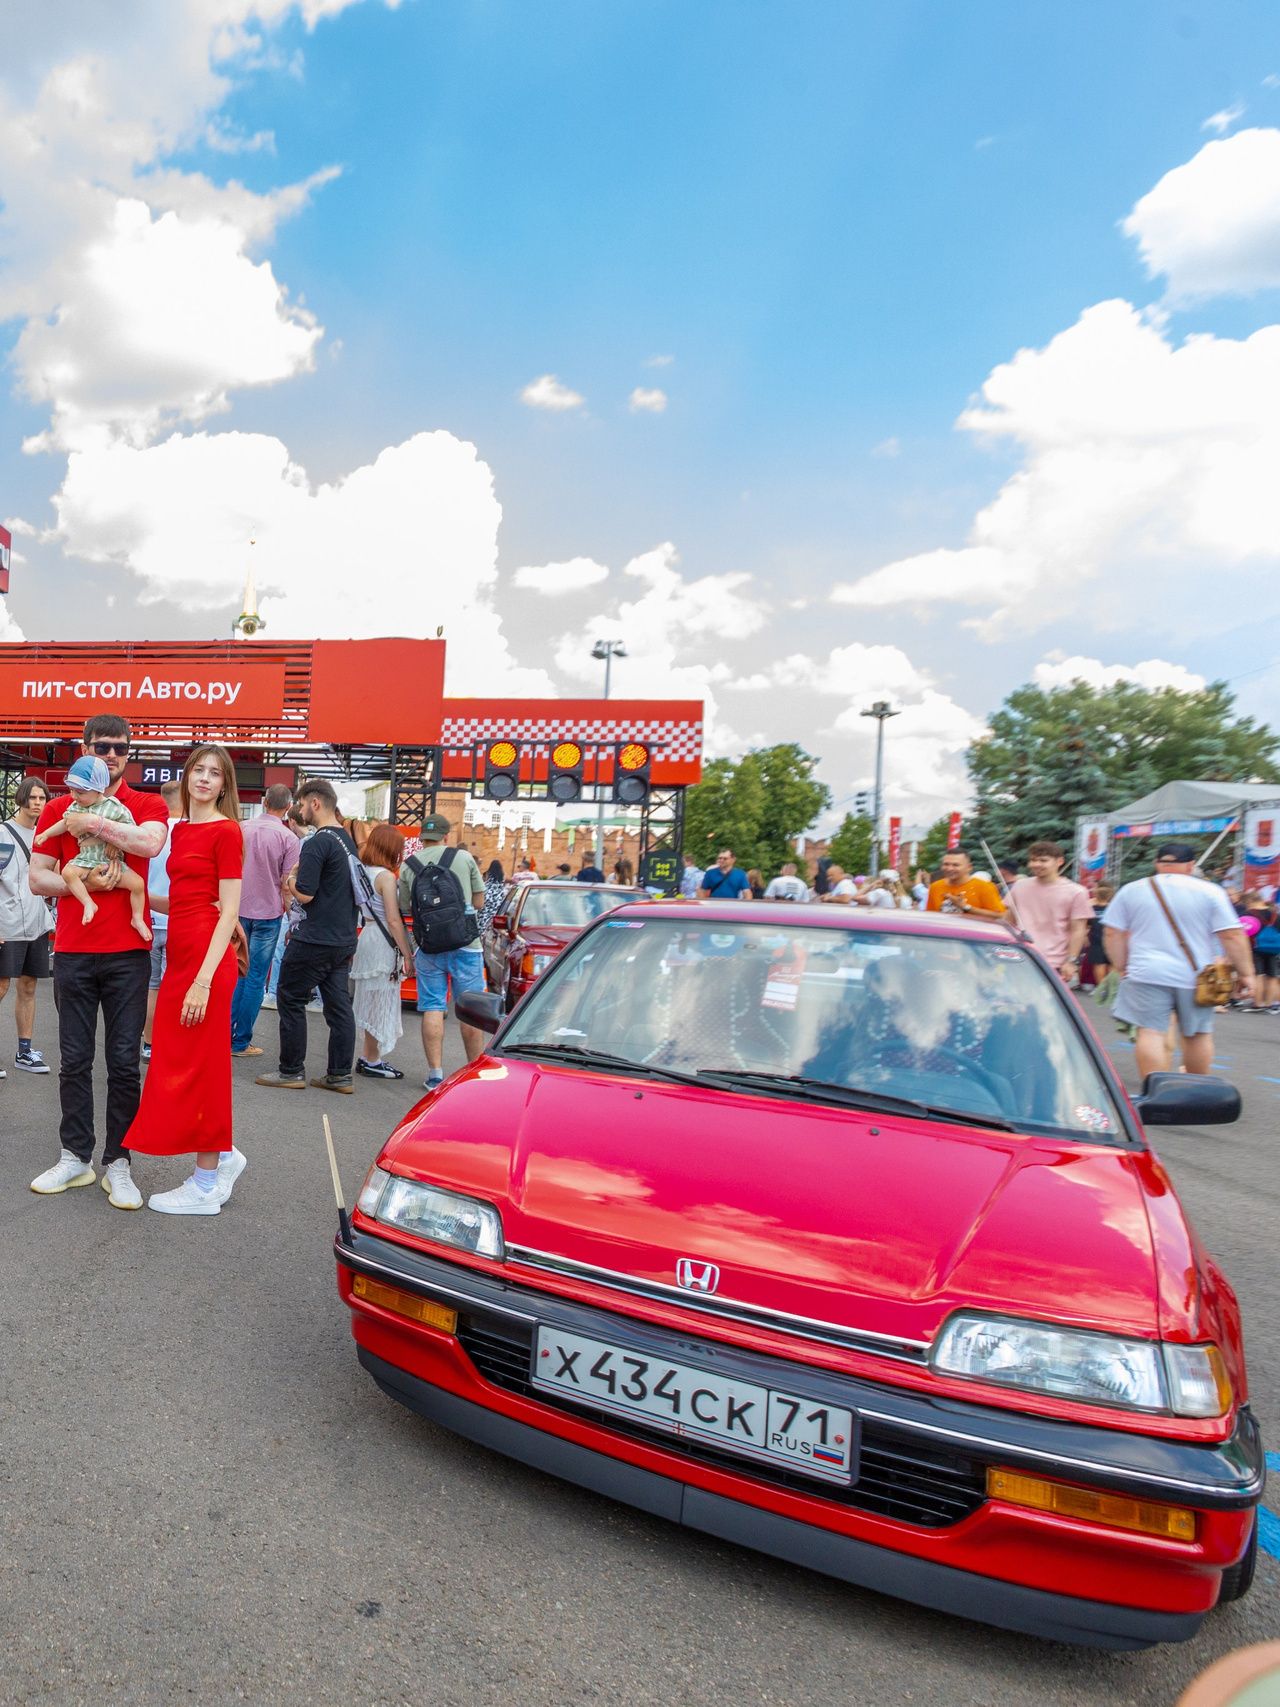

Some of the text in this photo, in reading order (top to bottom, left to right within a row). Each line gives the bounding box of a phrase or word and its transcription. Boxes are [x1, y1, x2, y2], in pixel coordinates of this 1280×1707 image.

[22, 676, 242, 705] пит-стоп Авто.ру
[554, 1344, 830, 1446] Х434СК 71
[771, 1432, 813, 1456] RUS
